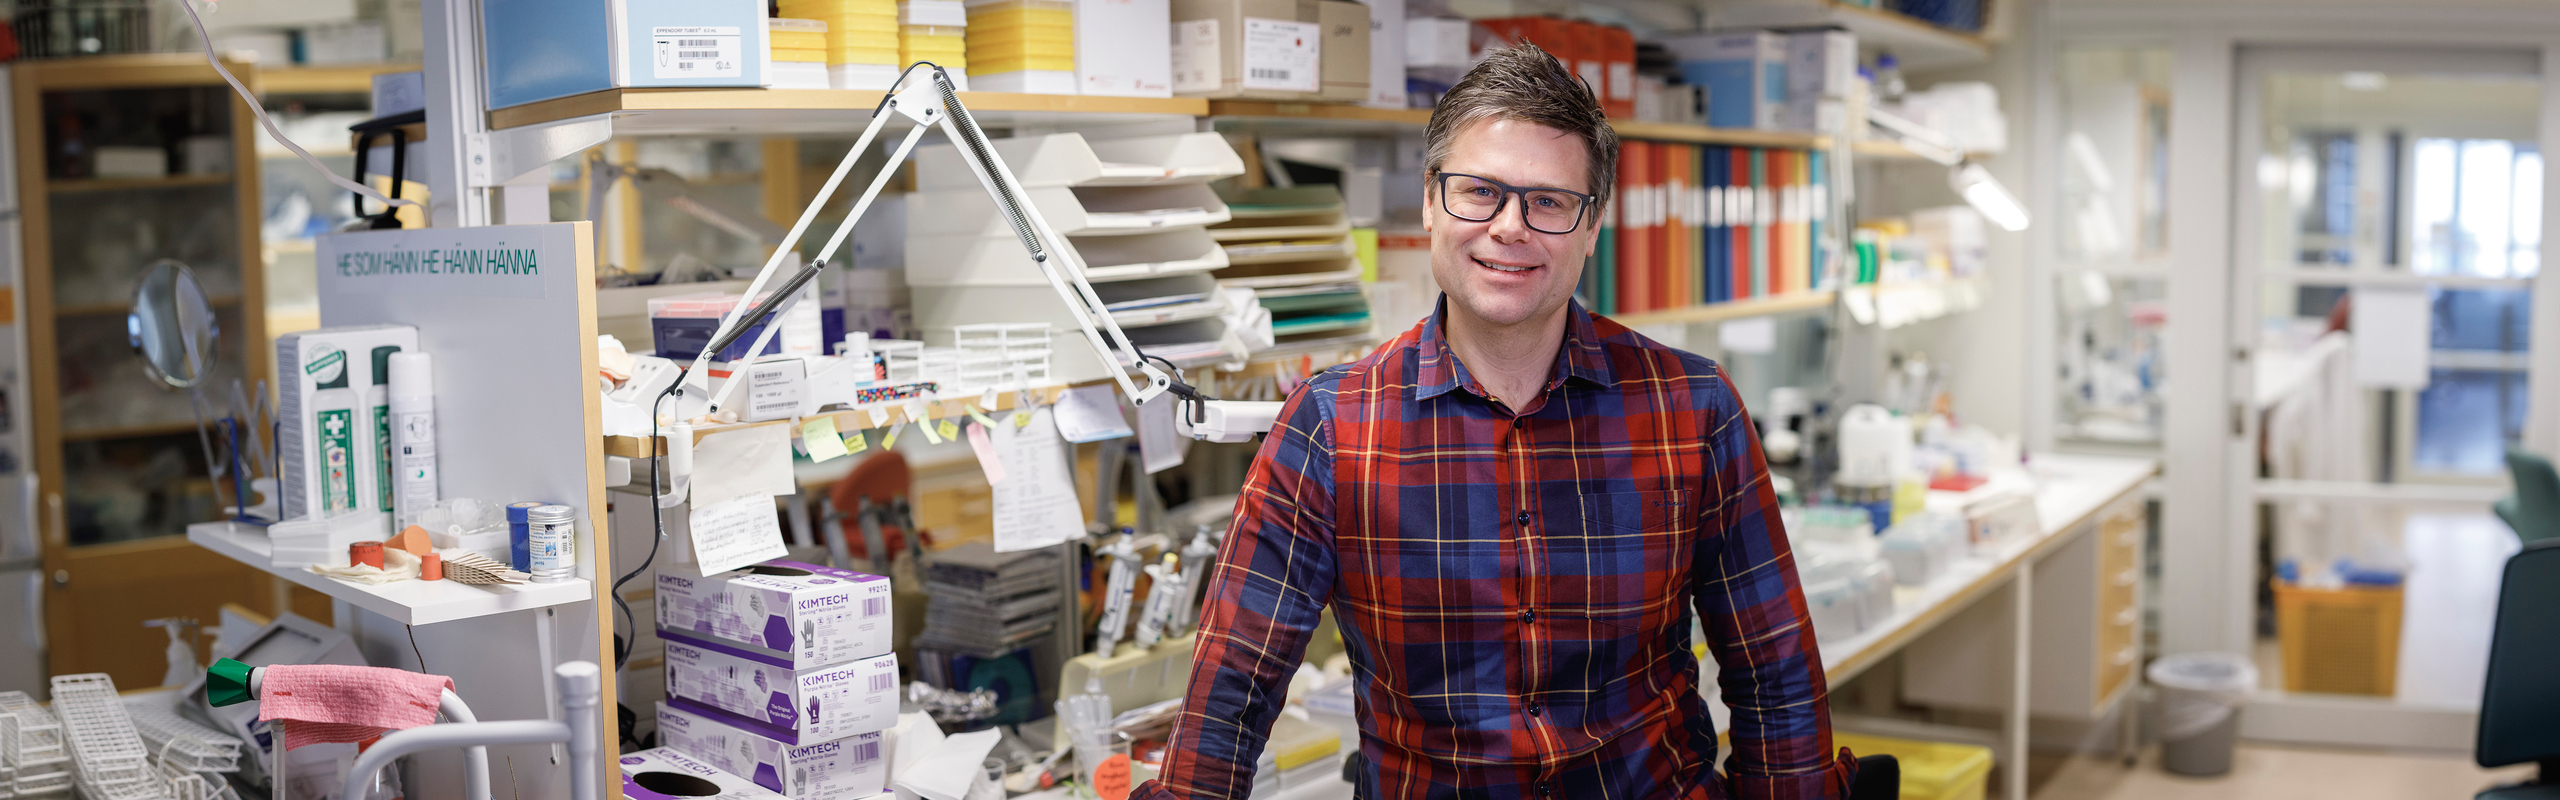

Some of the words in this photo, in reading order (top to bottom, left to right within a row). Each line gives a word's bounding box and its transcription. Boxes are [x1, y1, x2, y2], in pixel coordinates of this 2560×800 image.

[336, 251, 351, 277] HE
[353, 251, 382, 276] SOM
[383, 244, 419, 276] HÄNN
[421, 250, 440, 274] HE
[443, 242, 483, 275] HÄNN
[486, 241, 538, 275] HÄNNA
[658, 574, 694, 589] KIMTECH
[868, 584, 888, 594] 99212
[798, 593, 849, 610] KIMTECH
[804, 651, 814, 659] 150
[874, 659, 894, 669] 90628
[803, 669, 855, 687] KIMTECH
[810, 727, 819, 735] 100
[788, 741, 841, 760] KIMTECH
[654, 748, 718, 777] KIMTECH
